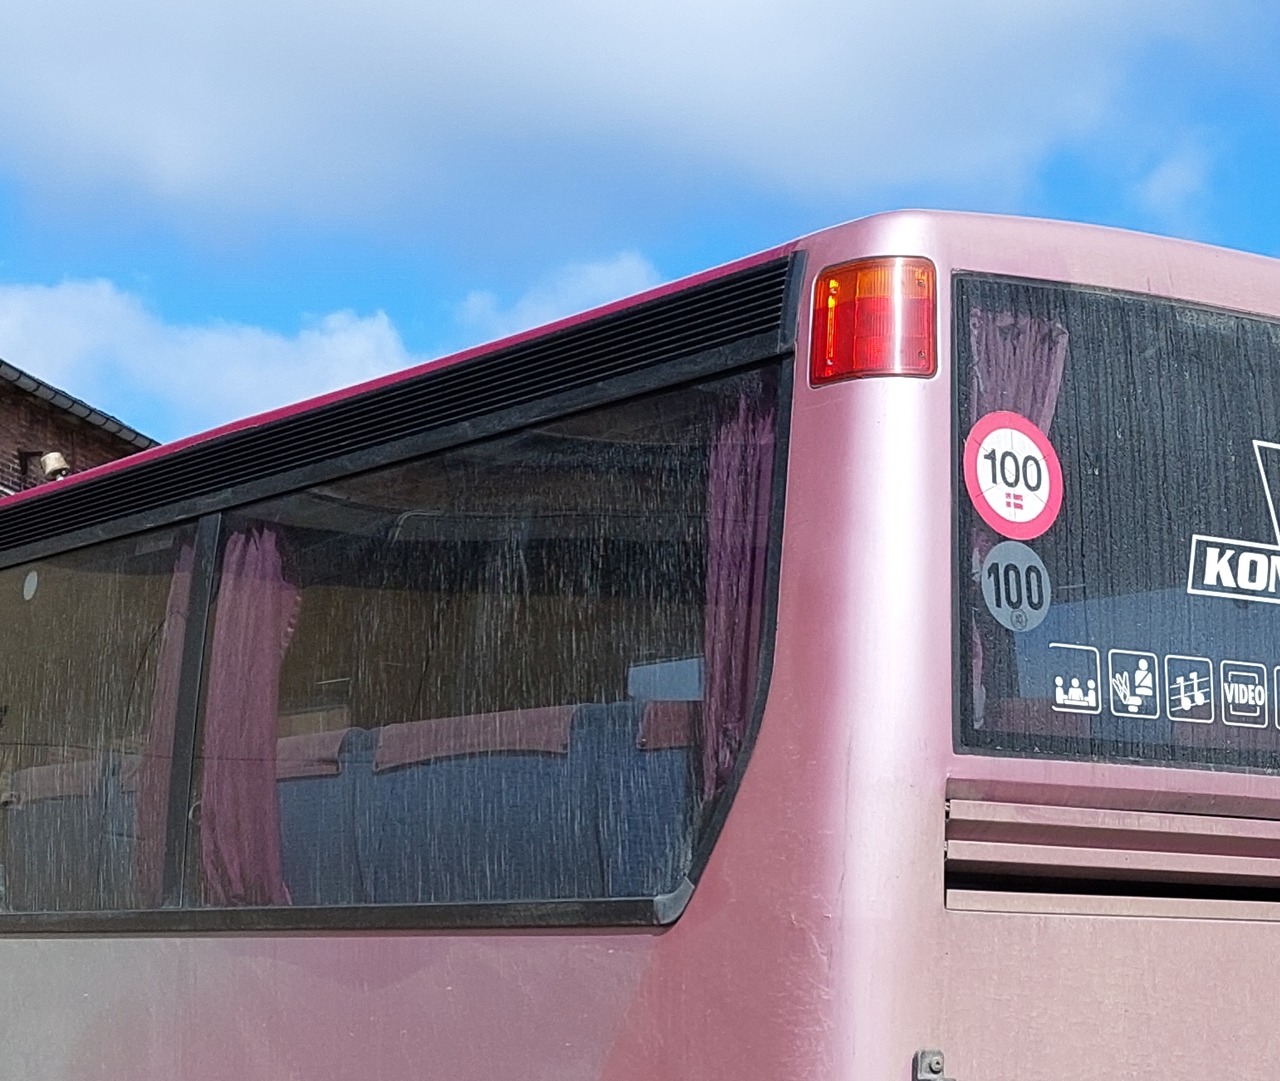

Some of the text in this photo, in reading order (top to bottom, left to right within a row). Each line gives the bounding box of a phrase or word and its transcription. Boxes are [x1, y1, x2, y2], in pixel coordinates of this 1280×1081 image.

[983, 447, 1042, 493] 100
[986, 561, 1045, 611] 100
[1223, 681, 1266, 707] VIDEO
